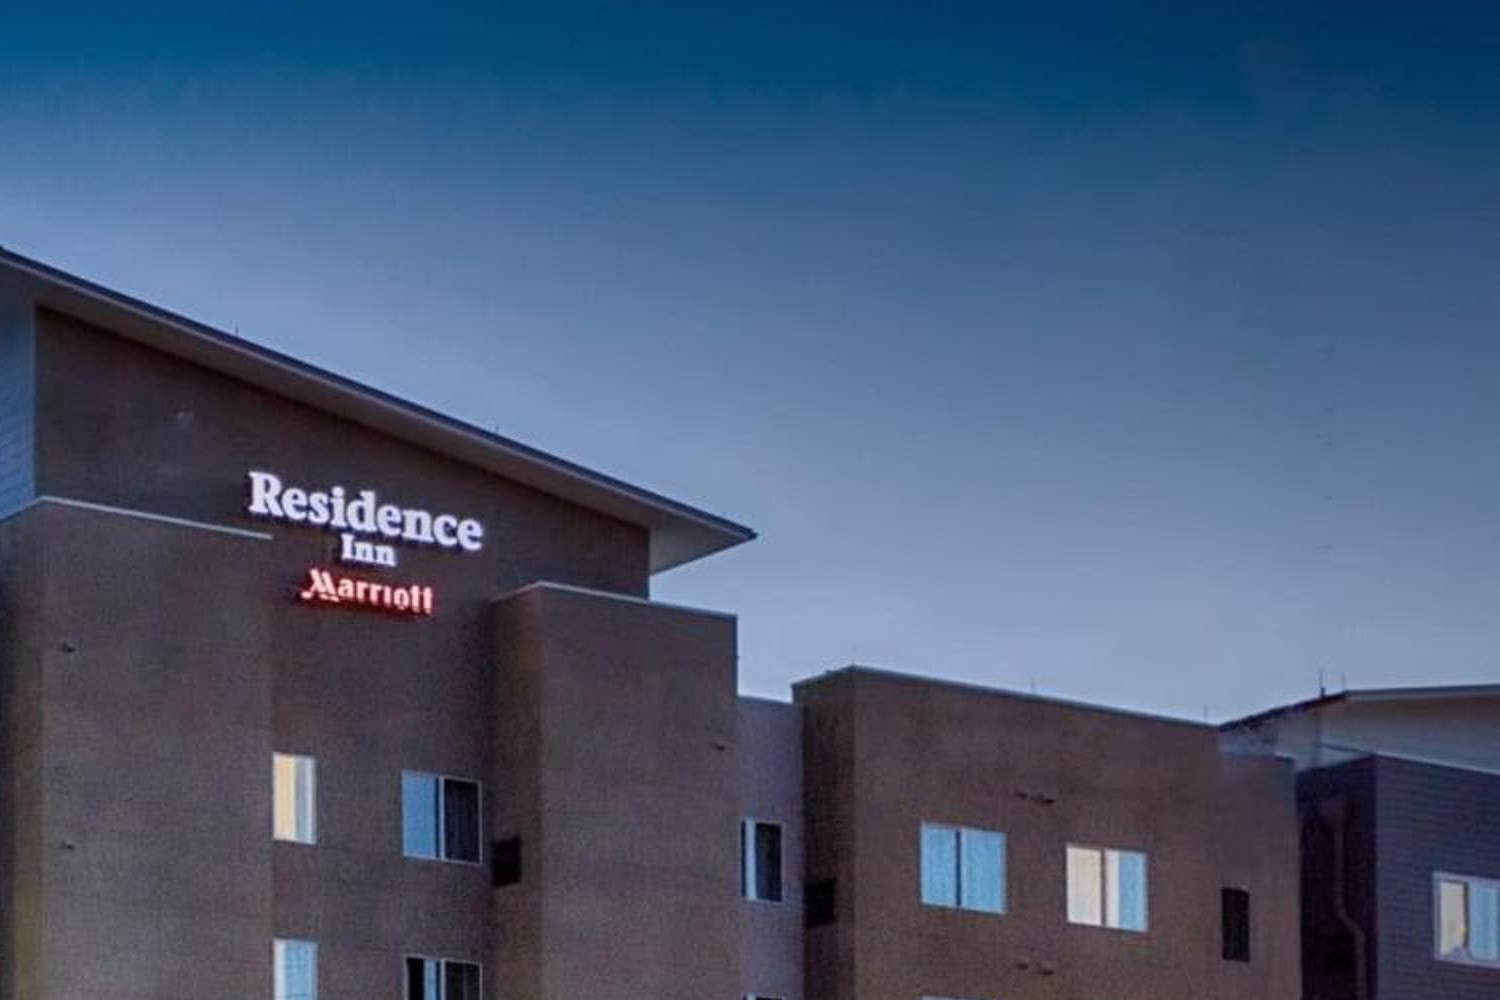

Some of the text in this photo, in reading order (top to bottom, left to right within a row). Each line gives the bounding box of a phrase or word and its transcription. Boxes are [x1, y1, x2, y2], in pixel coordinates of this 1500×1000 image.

[248, 471, 483, 550] Residence
[341, 533, 397, 566] Inn
[301, 568, 433, 614] Marriott
